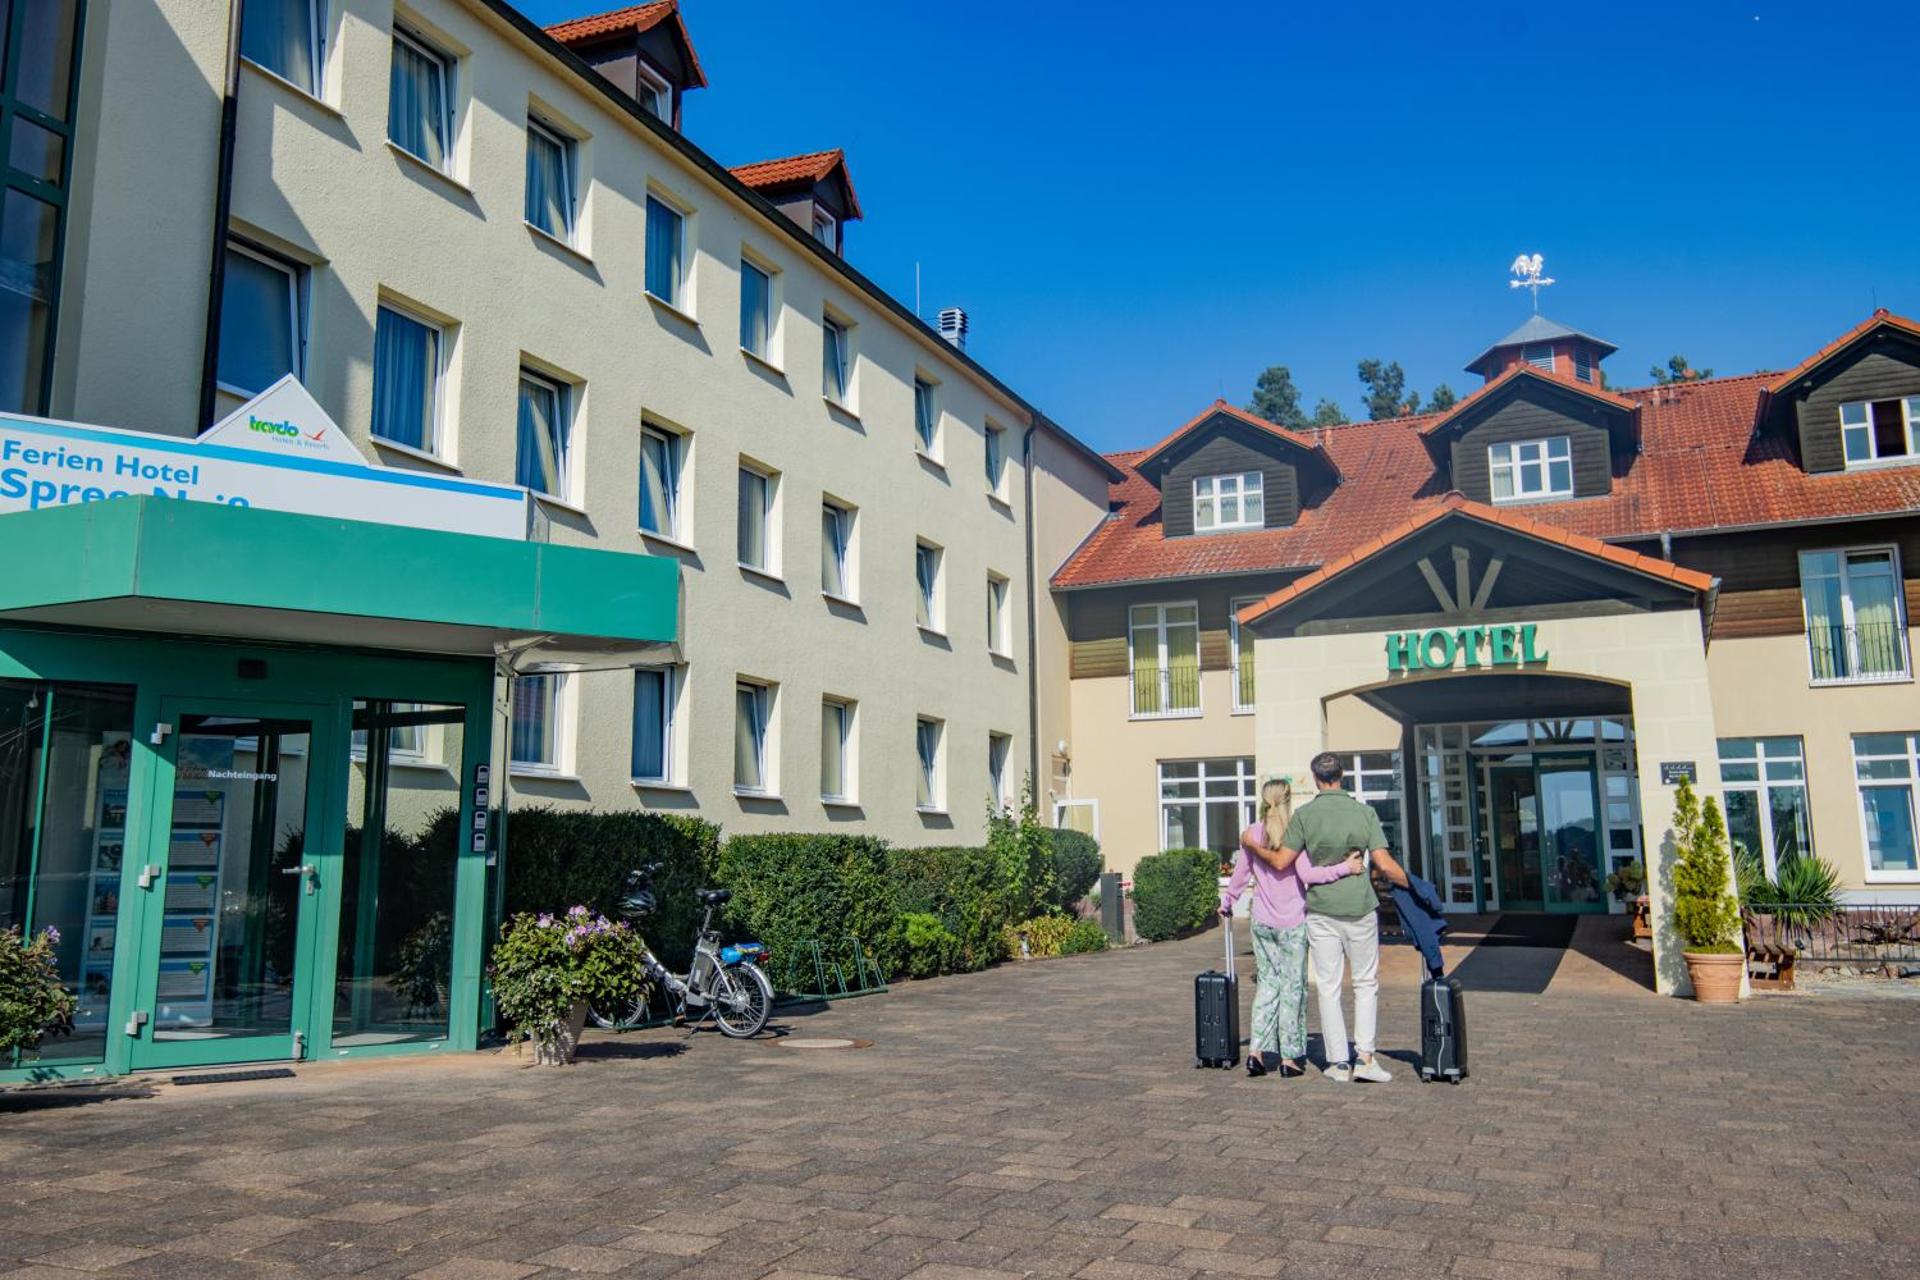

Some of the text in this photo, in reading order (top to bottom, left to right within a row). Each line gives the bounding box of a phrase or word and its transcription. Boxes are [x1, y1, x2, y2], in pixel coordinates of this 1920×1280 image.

[3, 439, 199, 485] Ferien Hotel
[1386, 623, 1549, 673] HOTEL
[208, 769, 278, 782] Nachteingang
